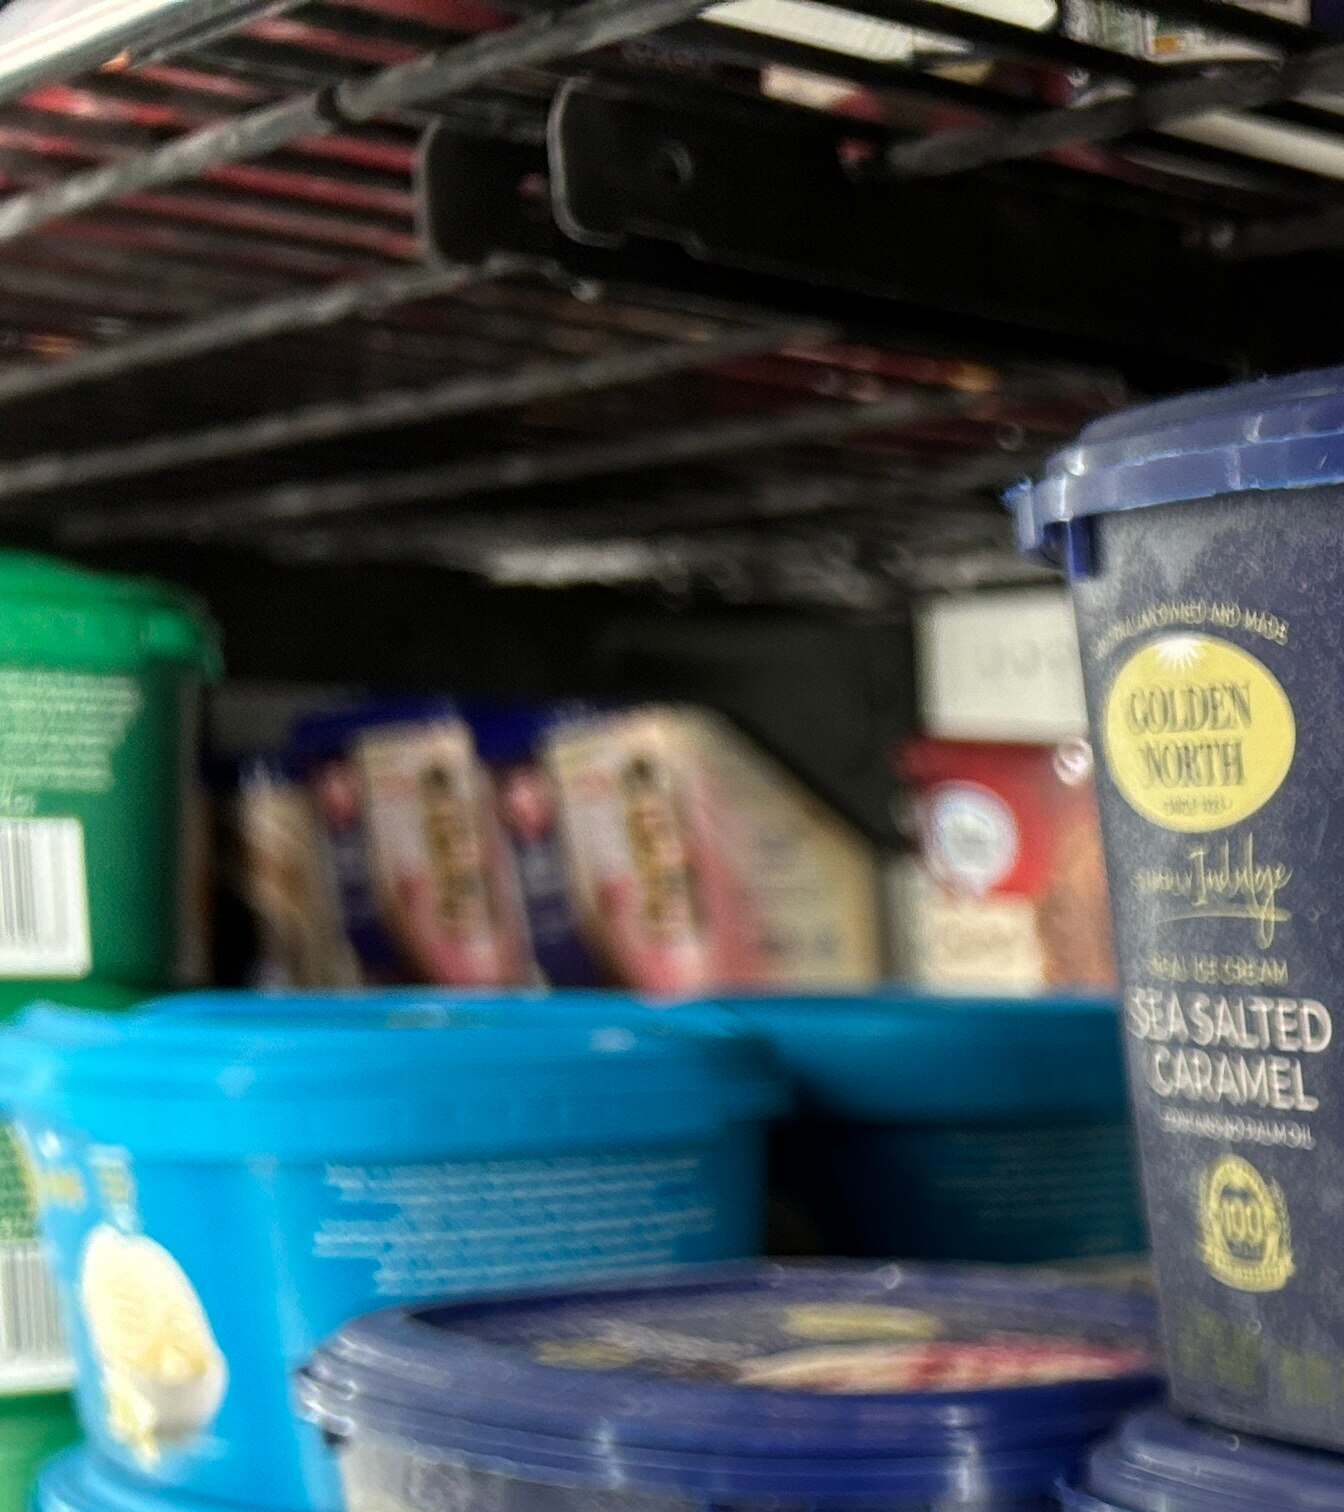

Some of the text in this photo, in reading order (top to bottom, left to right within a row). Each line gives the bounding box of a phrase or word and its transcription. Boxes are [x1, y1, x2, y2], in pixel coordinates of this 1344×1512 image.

[1129, 679, 1253, 737] GOLDEN
[1139, 737, 1247, 791] NORTH
[1126, 985, 1332, 1054] SEA SALTED
[1148, 1044, 1320, 1113] CARAMEL
